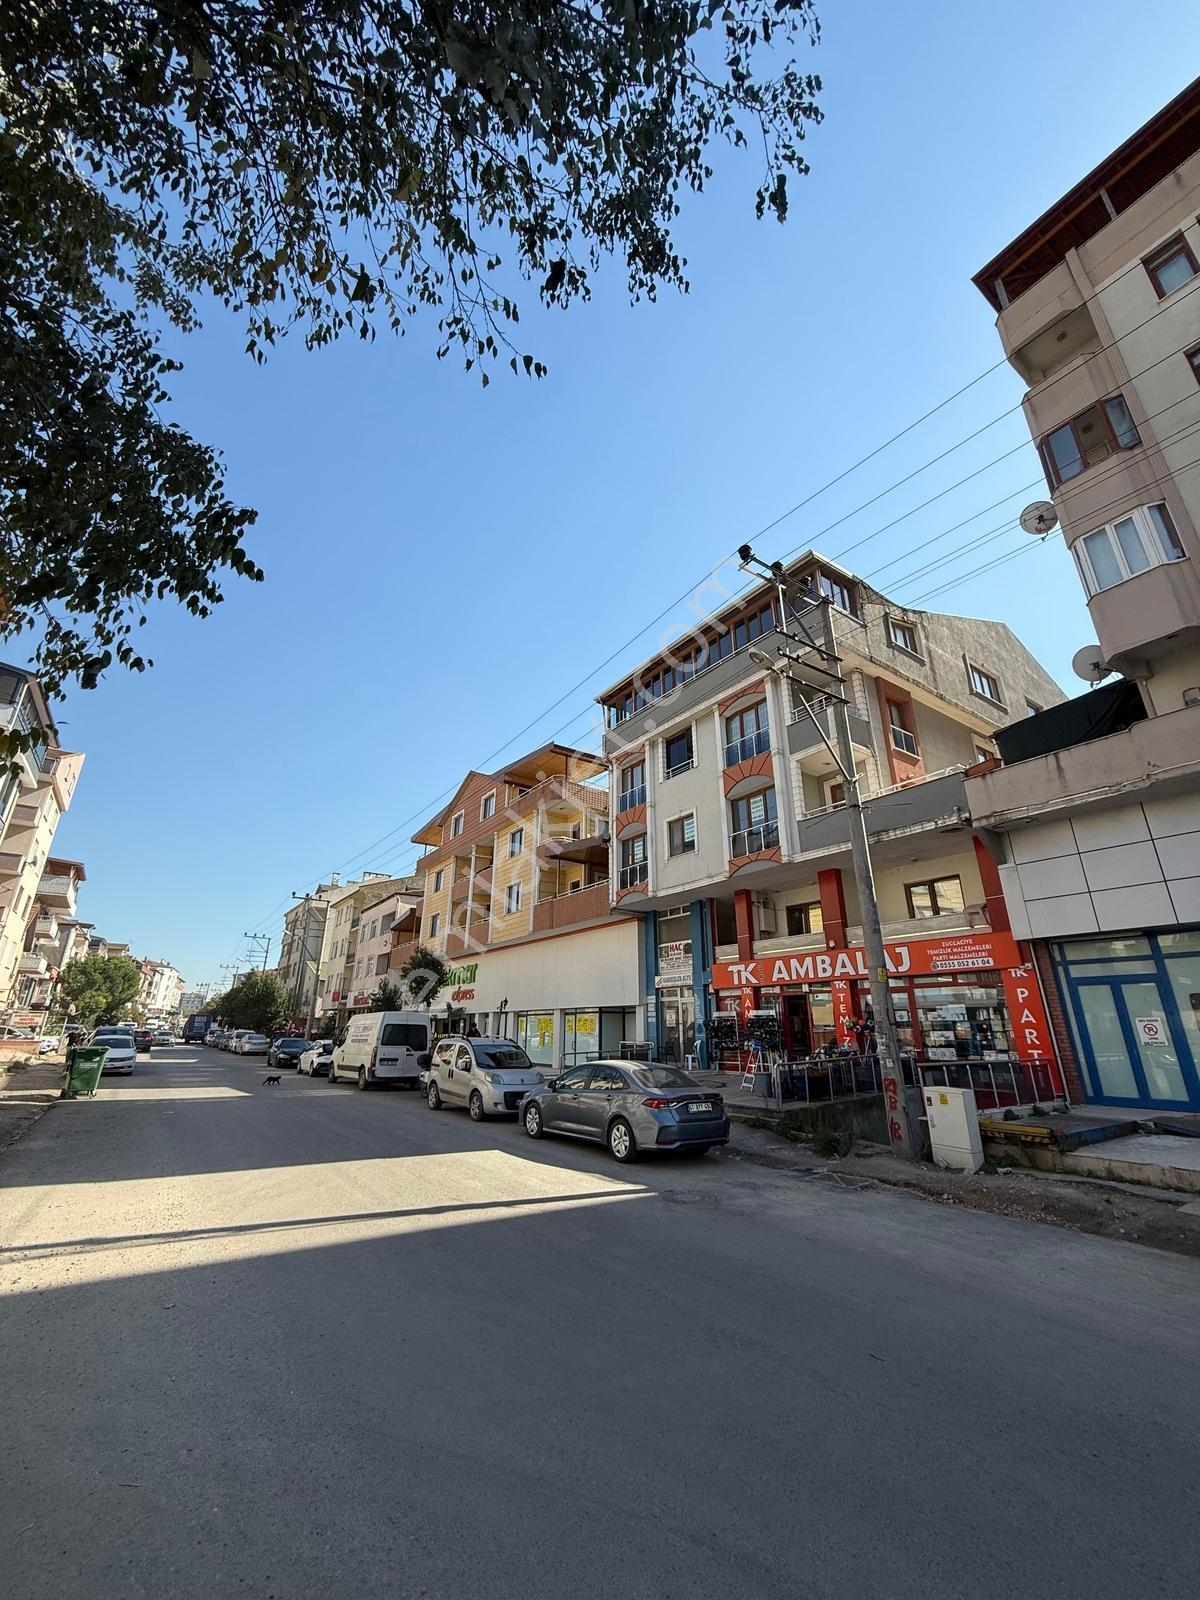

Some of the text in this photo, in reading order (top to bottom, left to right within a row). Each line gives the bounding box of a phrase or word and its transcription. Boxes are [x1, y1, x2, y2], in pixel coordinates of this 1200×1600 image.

[669, 943, 683, 952] HAC
[728, 963, 759, 985] TK
[1007, 967, 1029, 978] TK
[833, 980, 847, 989] TK
